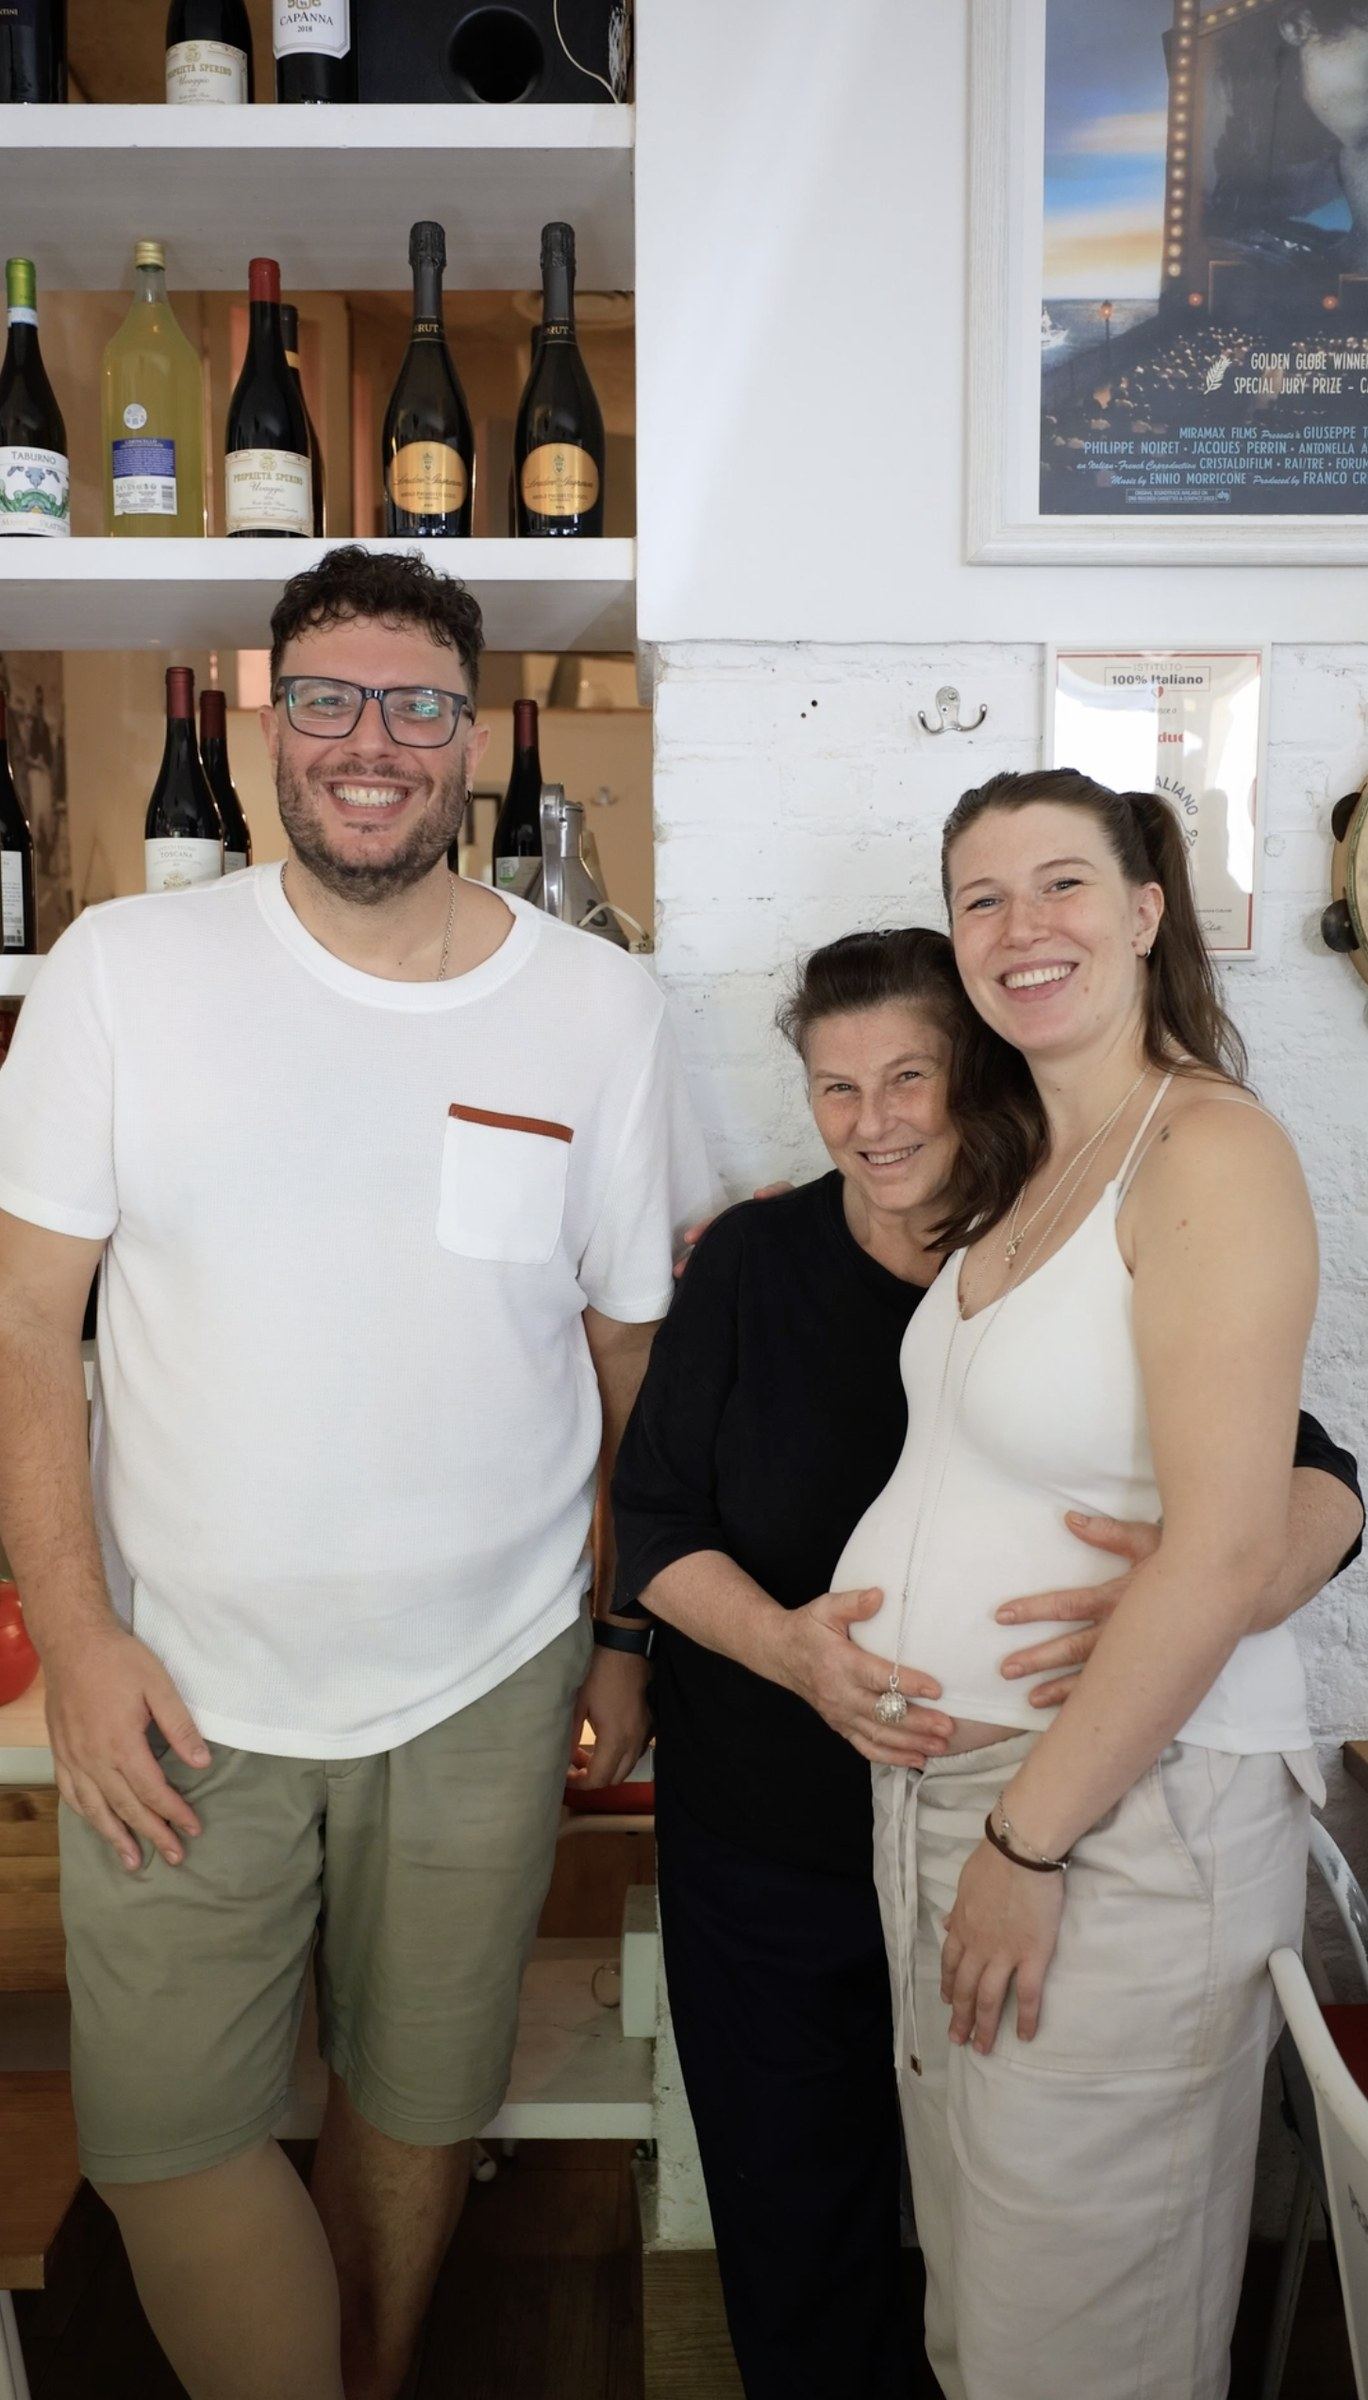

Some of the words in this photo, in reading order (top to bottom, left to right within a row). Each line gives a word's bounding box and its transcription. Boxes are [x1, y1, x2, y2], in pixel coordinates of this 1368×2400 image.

[280, 12, 334, 26] CAPANNA
[1250, 352, 1290, 370] GOLDEN
[1295, 352, 1327, 370] GLOBE
[1233, 377, 1275, 394] SPECIAL
[1281, 377, 1306, 394] JURY
[1312, 377, 1342, 394] PRIZE
[1360, 377, 1368, 394] C
[1179, 427, 1226, 439] MIRAMAX
[1231, 427, 1257, 439] FILMS
[1303, 426, 1356, 440] GIUSEPPE
[1084, 441, 1135, 455] PHILIPPE
[1140, 441, 1180, 454] NOIRET
[1191, 441, 1240, 455] JACQUES
[1246, 441, 1287, 454] PERRIN
[1298, 442, 1355, 454] ANTONELLA
[11, 451, 57, 465] TABURNO
[1199, 457, 1272, 469] CRISTALDIFILM
[1284, 457, 1325, 469] RAI/TRE
[1111, 474, 1136, 485] Music
[1137, 474, 1147, 486] by
[1149, 472, 1181, 485] ENNIO
[1186, 472, 1247, 485] MORRICONE
[1252, 474, 1289, 485] Produced
[1290, 475, 1300, 486] by
[1303, 471, 1348, 485] FRANCO
[1133, 663, 1183, 672] ISTITUTO
[1111, 674, 1148, 685] 100%
[1151, 674, 1204, 685] Italiano
[1154, 775, 1199, 816] ALIANO
[160, 850, 194, 859] TOSCANA
